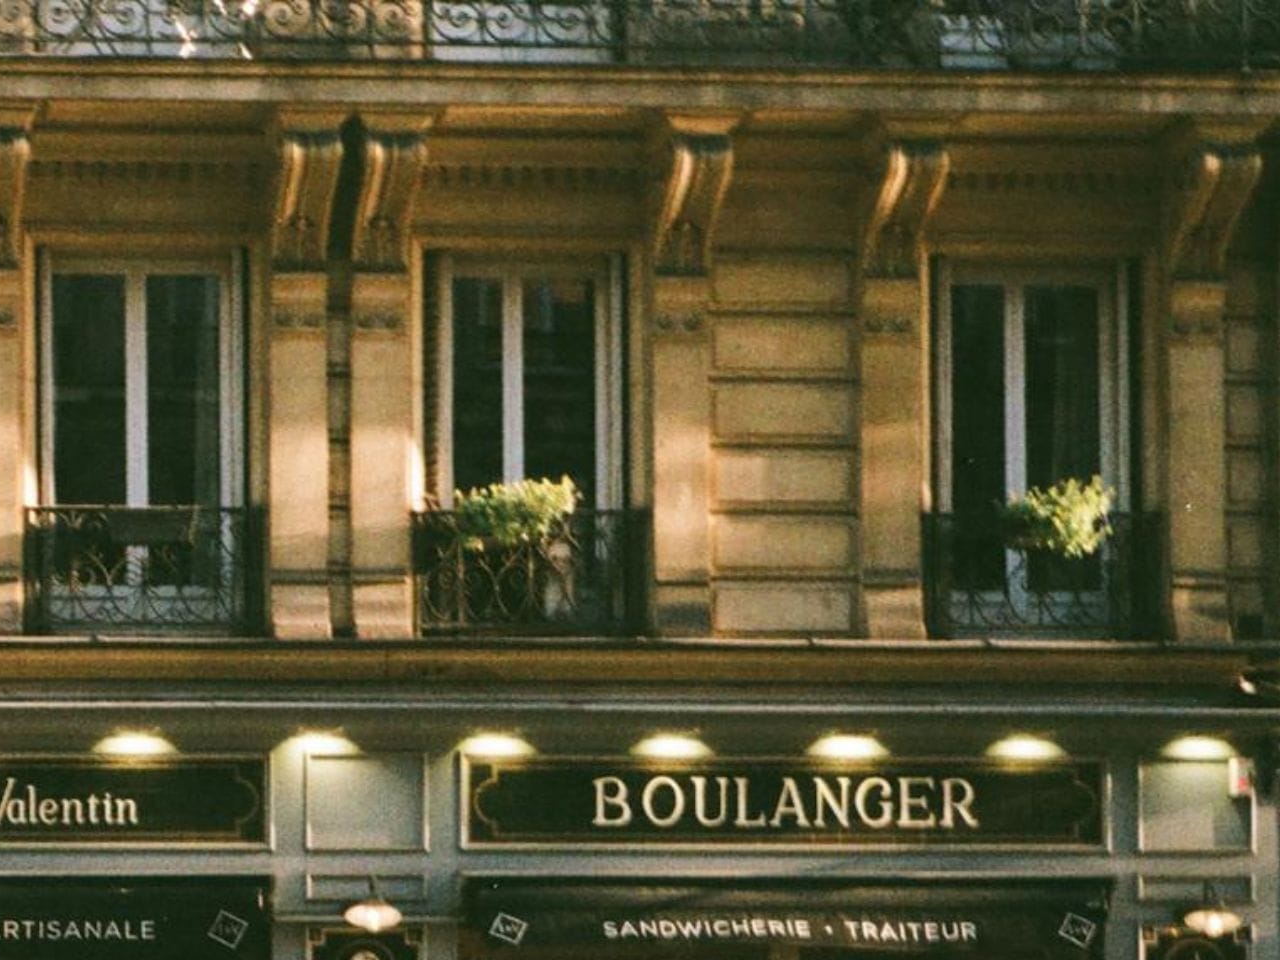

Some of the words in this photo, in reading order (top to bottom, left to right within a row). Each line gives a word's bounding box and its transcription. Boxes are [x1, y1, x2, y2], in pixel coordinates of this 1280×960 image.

[592, 775, 980, 829] BOULANGER
[602, 918, 811, 941] SANDWICHERIE
[844, 919, 978, 943] TRAITEUR
